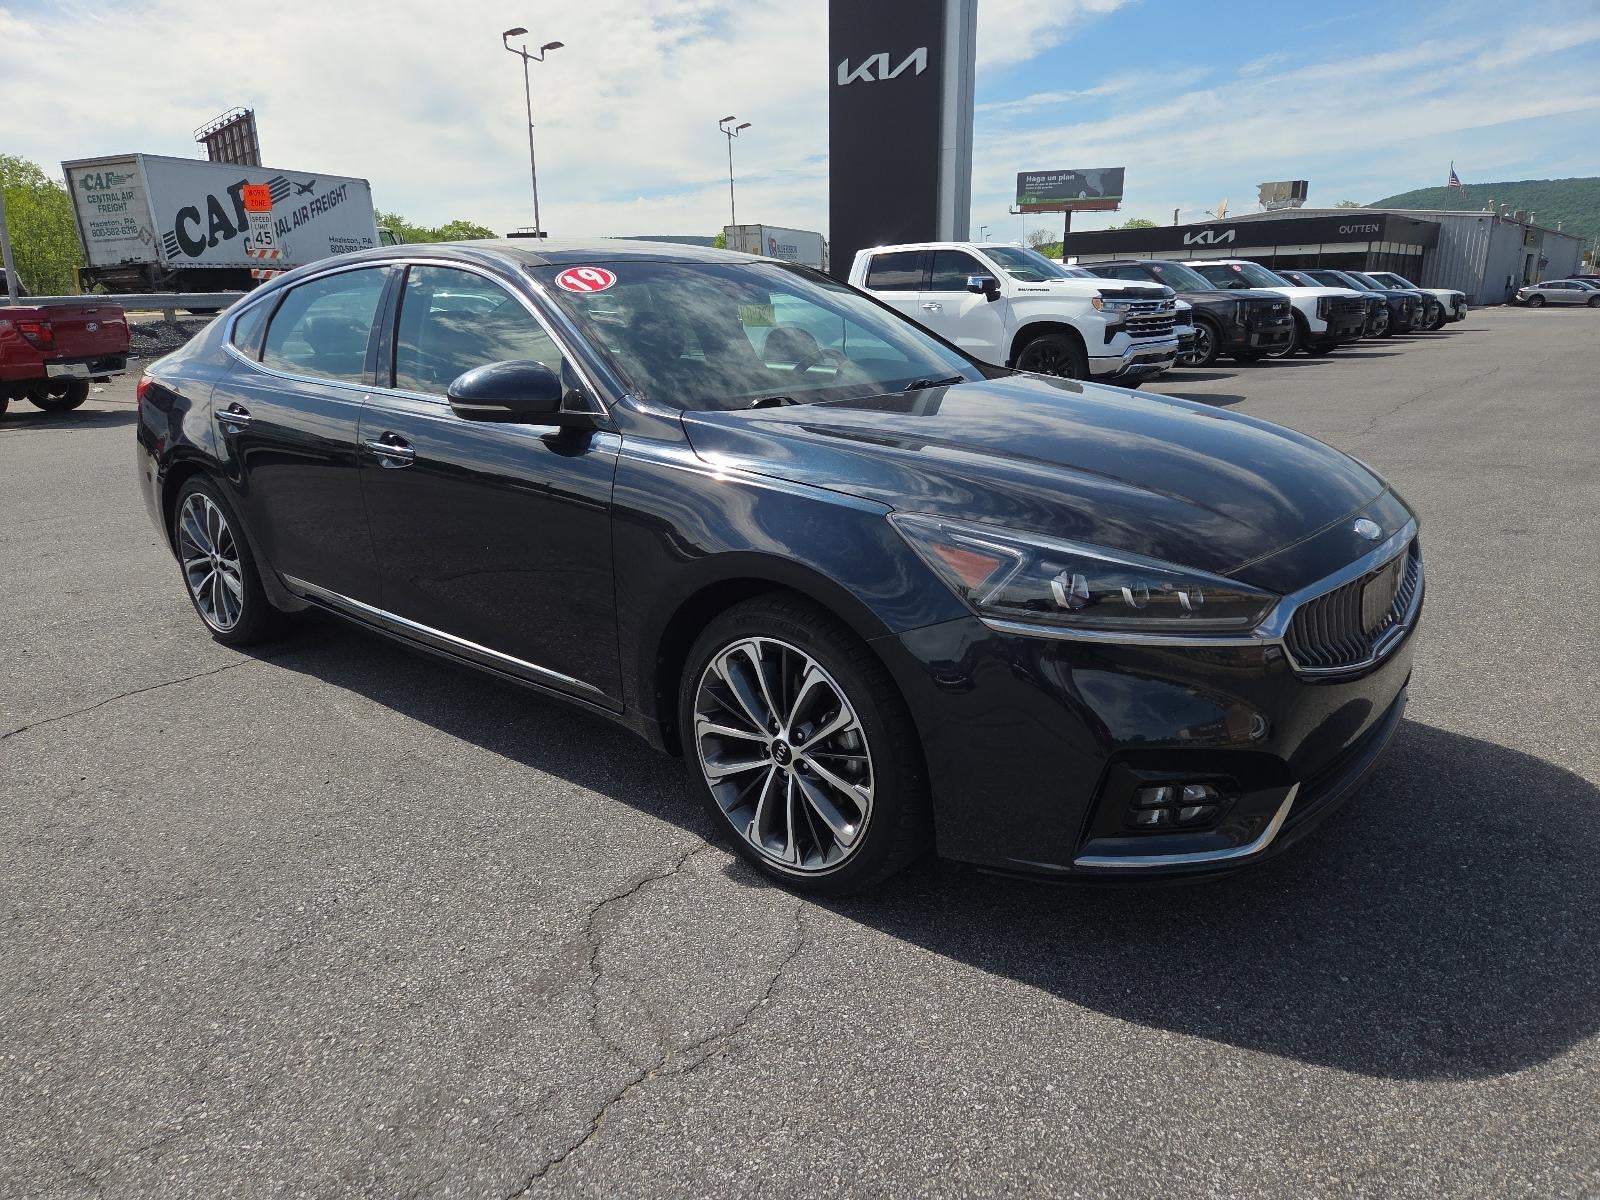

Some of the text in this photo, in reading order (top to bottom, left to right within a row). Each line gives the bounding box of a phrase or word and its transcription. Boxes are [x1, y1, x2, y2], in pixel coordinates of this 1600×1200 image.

[837, 46, 928, 86] KIA
[84, 171, 115, 191] CAF
[1026, 174, 1046, 183] Haga
[1058, 173, 1075, 182] plan
[87, 191, 135, 204] CENTRAL AIR
[247, 189, 266, 197] WORK
[97, 202, 128, 213] FREIGHT
[292, 184, 348, 229] AIR FREIGHT
[123, 217, 136, 225] PA
[1338, 223, 1379, 234] OUTTEN
[255, 231, 273, 245] 45
[362, 237, 373, 245] PA
[1183, 229, 1236, 245] KIA
[563, 268, 607, 291] 19
[775, 742, 787, 762] KIA
